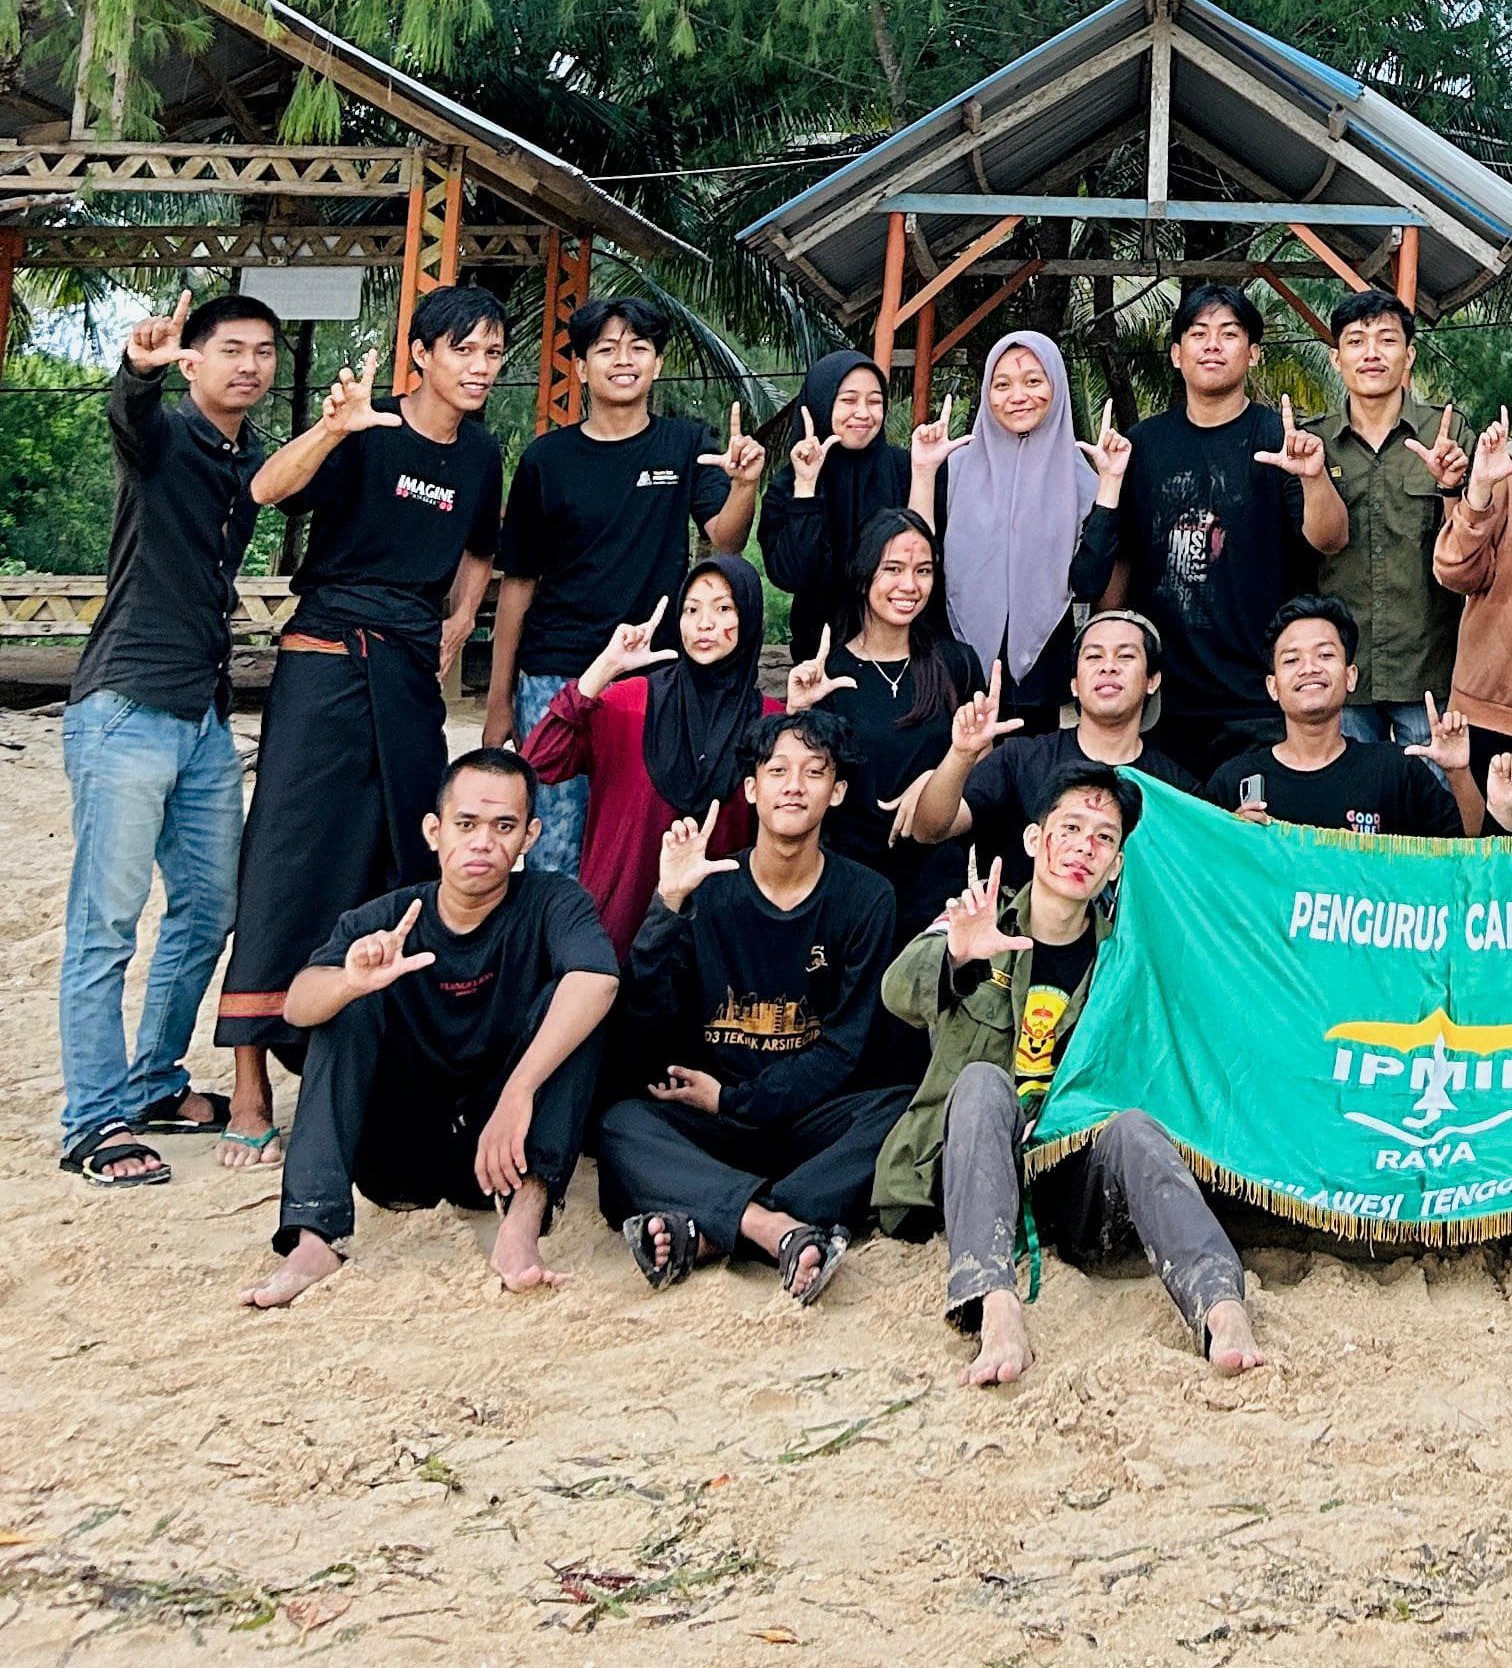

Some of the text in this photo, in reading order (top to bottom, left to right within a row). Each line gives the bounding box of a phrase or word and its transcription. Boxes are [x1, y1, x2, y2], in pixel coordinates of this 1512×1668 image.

[397, 474, 456, 503] IMAGINE
[1289, 891, 1449, 951] PENGURUS
[1375, 1141, 1476, 1170] RAYA
